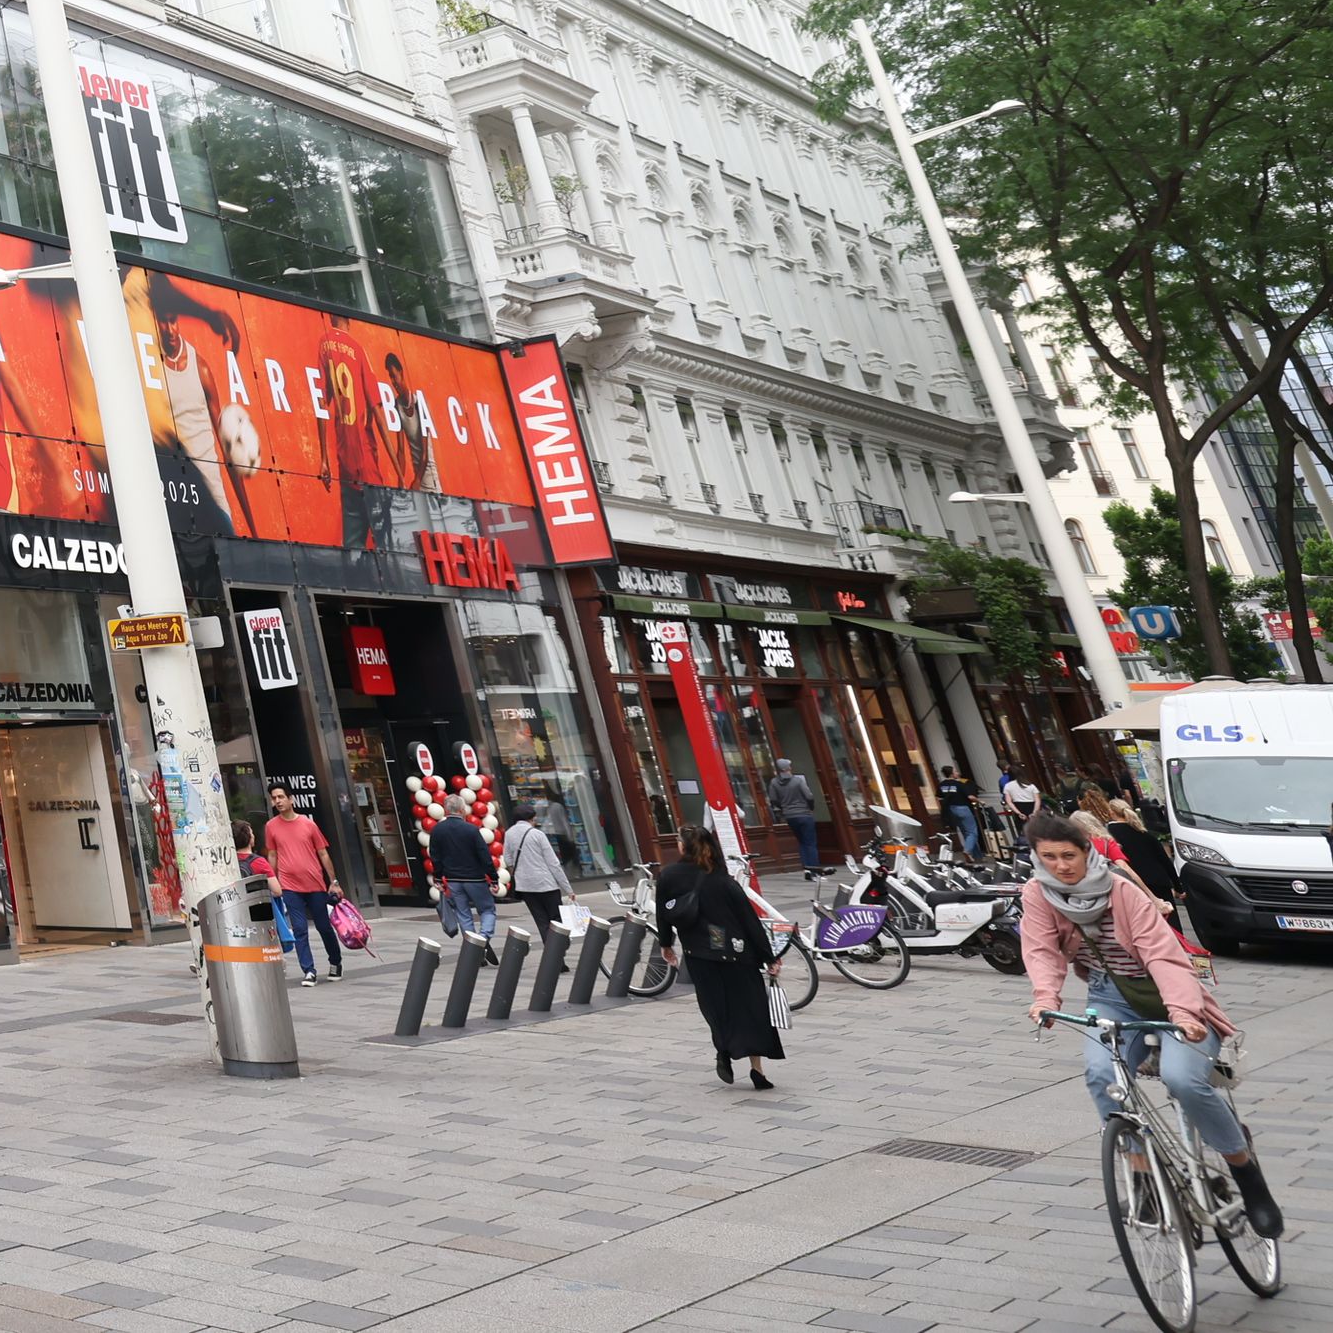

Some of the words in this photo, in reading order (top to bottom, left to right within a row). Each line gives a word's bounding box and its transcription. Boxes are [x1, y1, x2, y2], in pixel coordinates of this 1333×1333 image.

[78, 66, 149, 109] lever
[226, 350, 330, 420] ARE
[378, 381, 501, 450] BACK
[329, 359, 356, 425] 19
[518, 374, 595, 526] HEMA
[11, 533, 128, 576] CALZED
[419, 529, 521, 592] HEMA
[617, 571, 683, 594] JACK&JONES
[734, 582, 792, 604] JACK&JONES
[652, 601, 690, 615] JACK&JONES
[121, 624, 134, 632] Haus
[136, 623, 147, 631] des
[147, 621, 168, 630] Meeres
[249, 616, 280, 631] clever
[1136, 614, 1166, 635] U
[125, 634, 140, 645] Aqua
[141, 633, 156, 642] Terra
[157, 632, 168, 641] Zoo
[758, 629, 790, 648] JACK&
[252, 628, 293, 680] fit
[356, 647, 388, 665] HEMA
[764, 648, 795, 668] JONES
[346, 735, 361, 744] eu
[288, 775, 316, 789] WEG
[28, 800, 100, 811] CALZEDONIA
[1286, 919, 1295, 927] W
[1302, 919, 1333, 929] 8634
